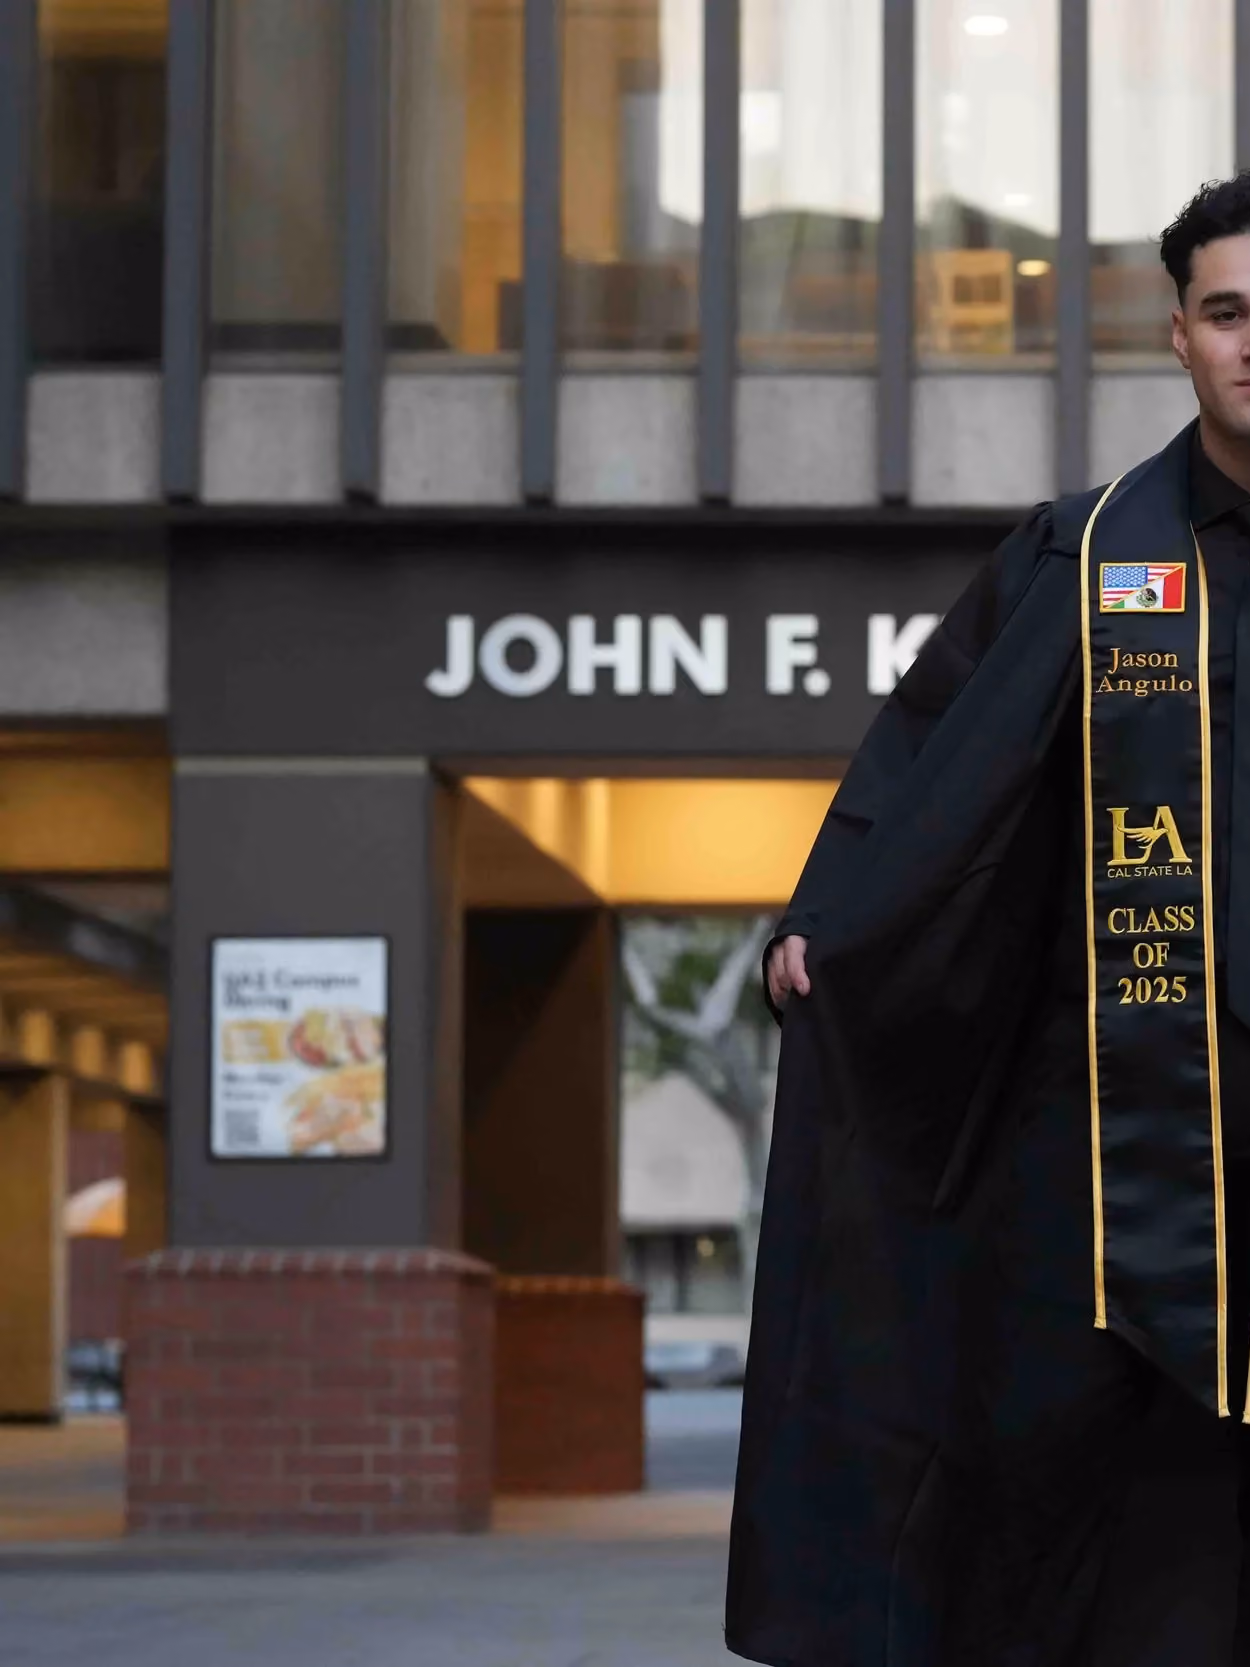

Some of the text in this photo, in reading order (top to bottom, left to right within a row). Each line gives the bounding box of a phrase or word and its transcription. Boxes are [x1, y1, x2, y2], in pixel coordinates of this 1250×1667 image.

[426, 614, 728, 696] JOHN
[766, 614, 830, 696] F.
[1107, 647, 1179, 674] Jason
[1096, 674, 1193, 698] Angulo
[1107, 862, 1193, 879] CAL STATE LA
[1107, 905, 1195, 934] CLASS
[1133, 942, 1170, 969] OF
[1117, 976, 1187, 1006] 2025
